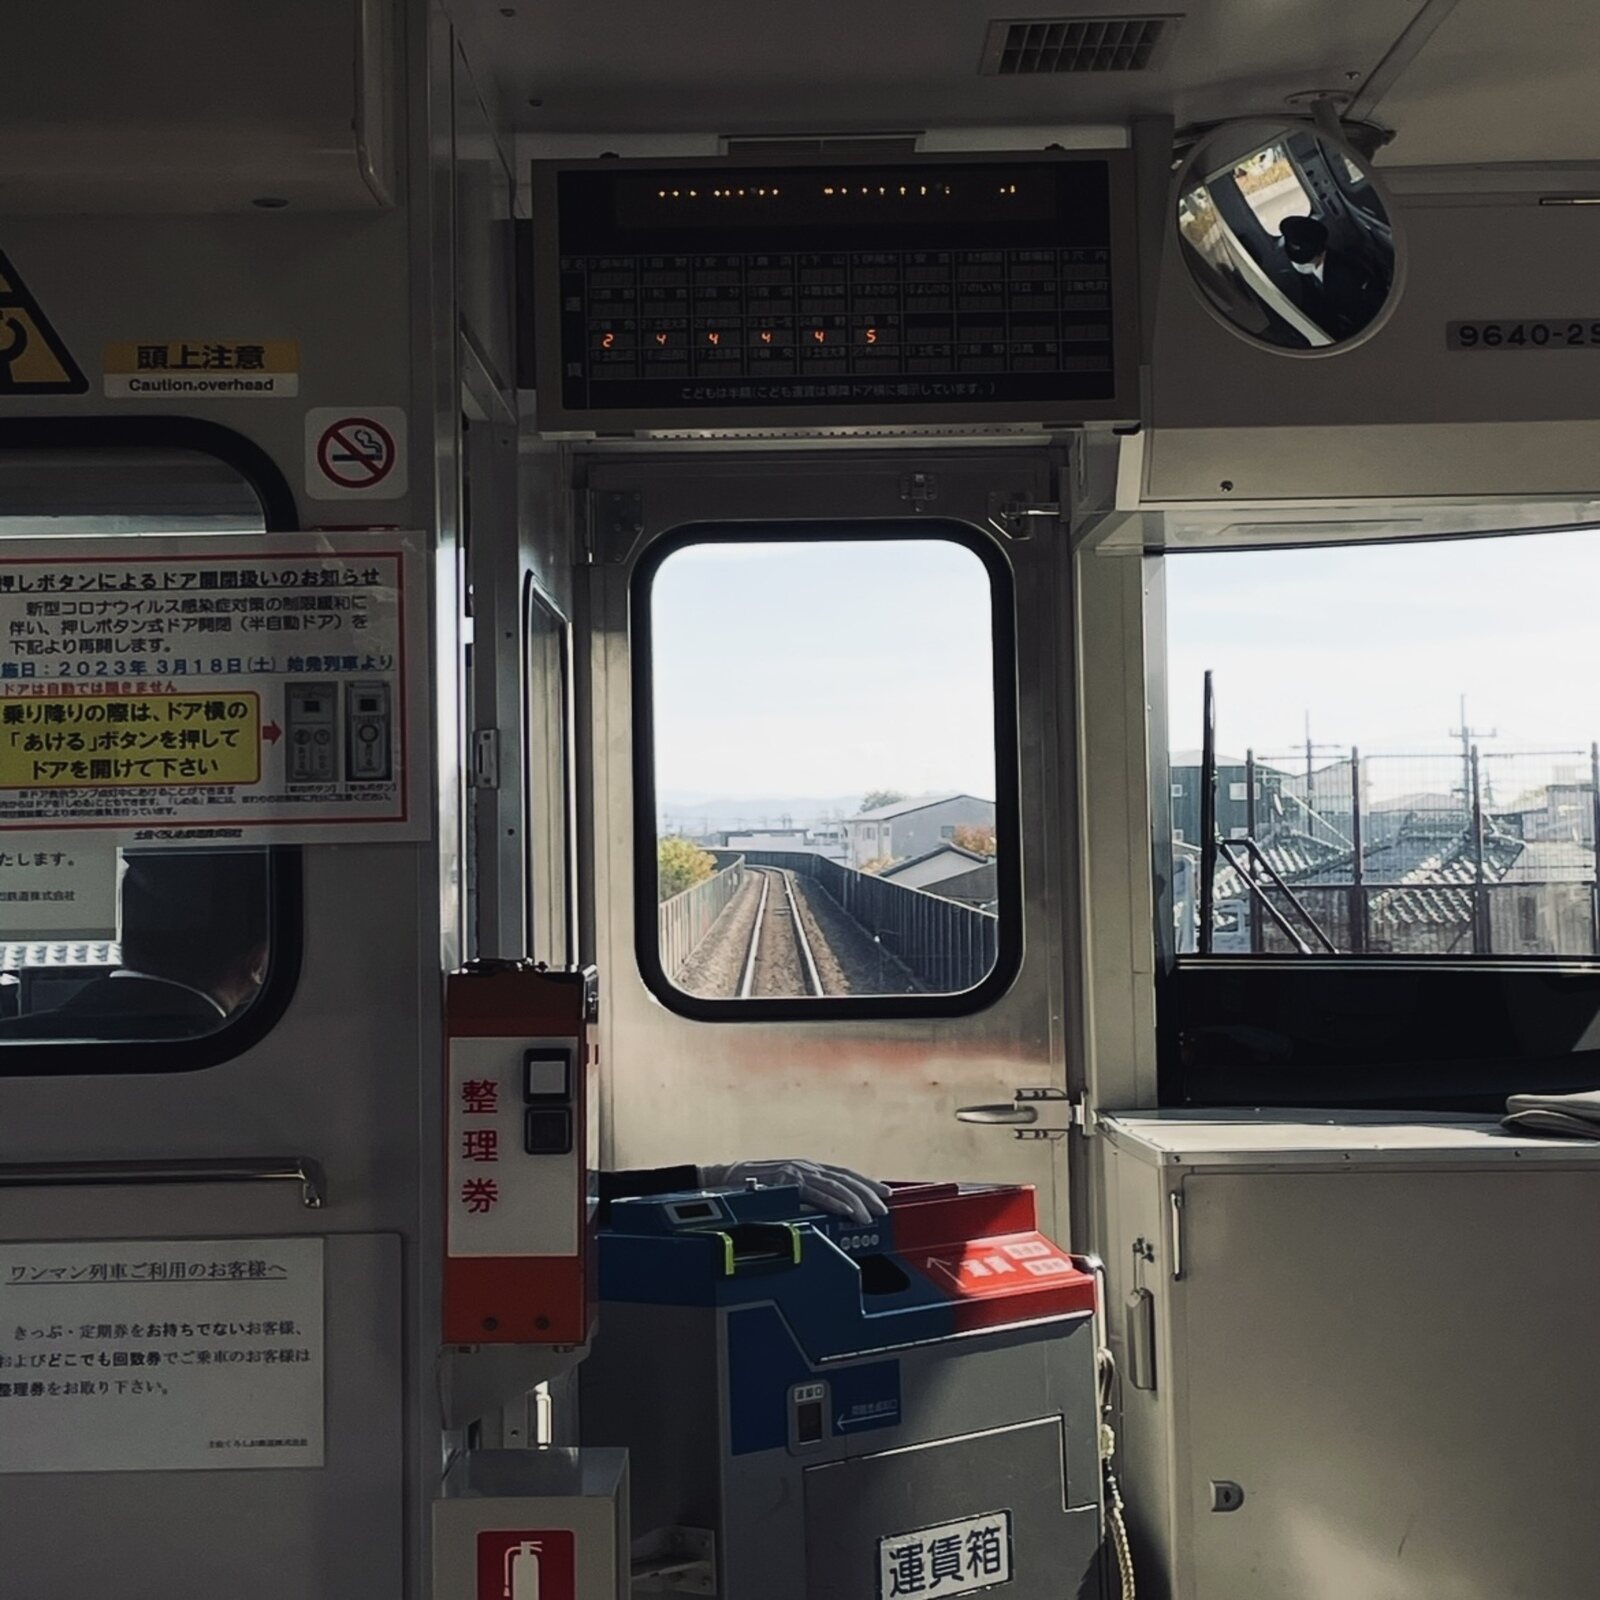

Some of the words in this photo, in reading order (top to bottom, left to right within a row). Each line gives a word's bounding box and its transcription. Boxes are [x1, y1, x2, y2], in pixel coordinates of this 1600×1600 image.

[602, 332, 614, 348] 2
[137, 345, 265, 370] 頭上注意
[10, 637, 171, 655] 下記より再開します。
[3, 700, 249, 725] 乗り降りの際は、ドア横の
[10, 729, 241, 752] 「あける」ボタンを押して
[32, 758, 219, 780] ドアを開けて下さい
[461, 1079, 499, 1214] 整理券
[10, 1261, 287, 1281] ワンマン列車ご利用のお客様へ
[0, 1380, 169, 1397] 整理券をお取り下さい。
[889, 1526, 1001, 1598] 運賃箱
